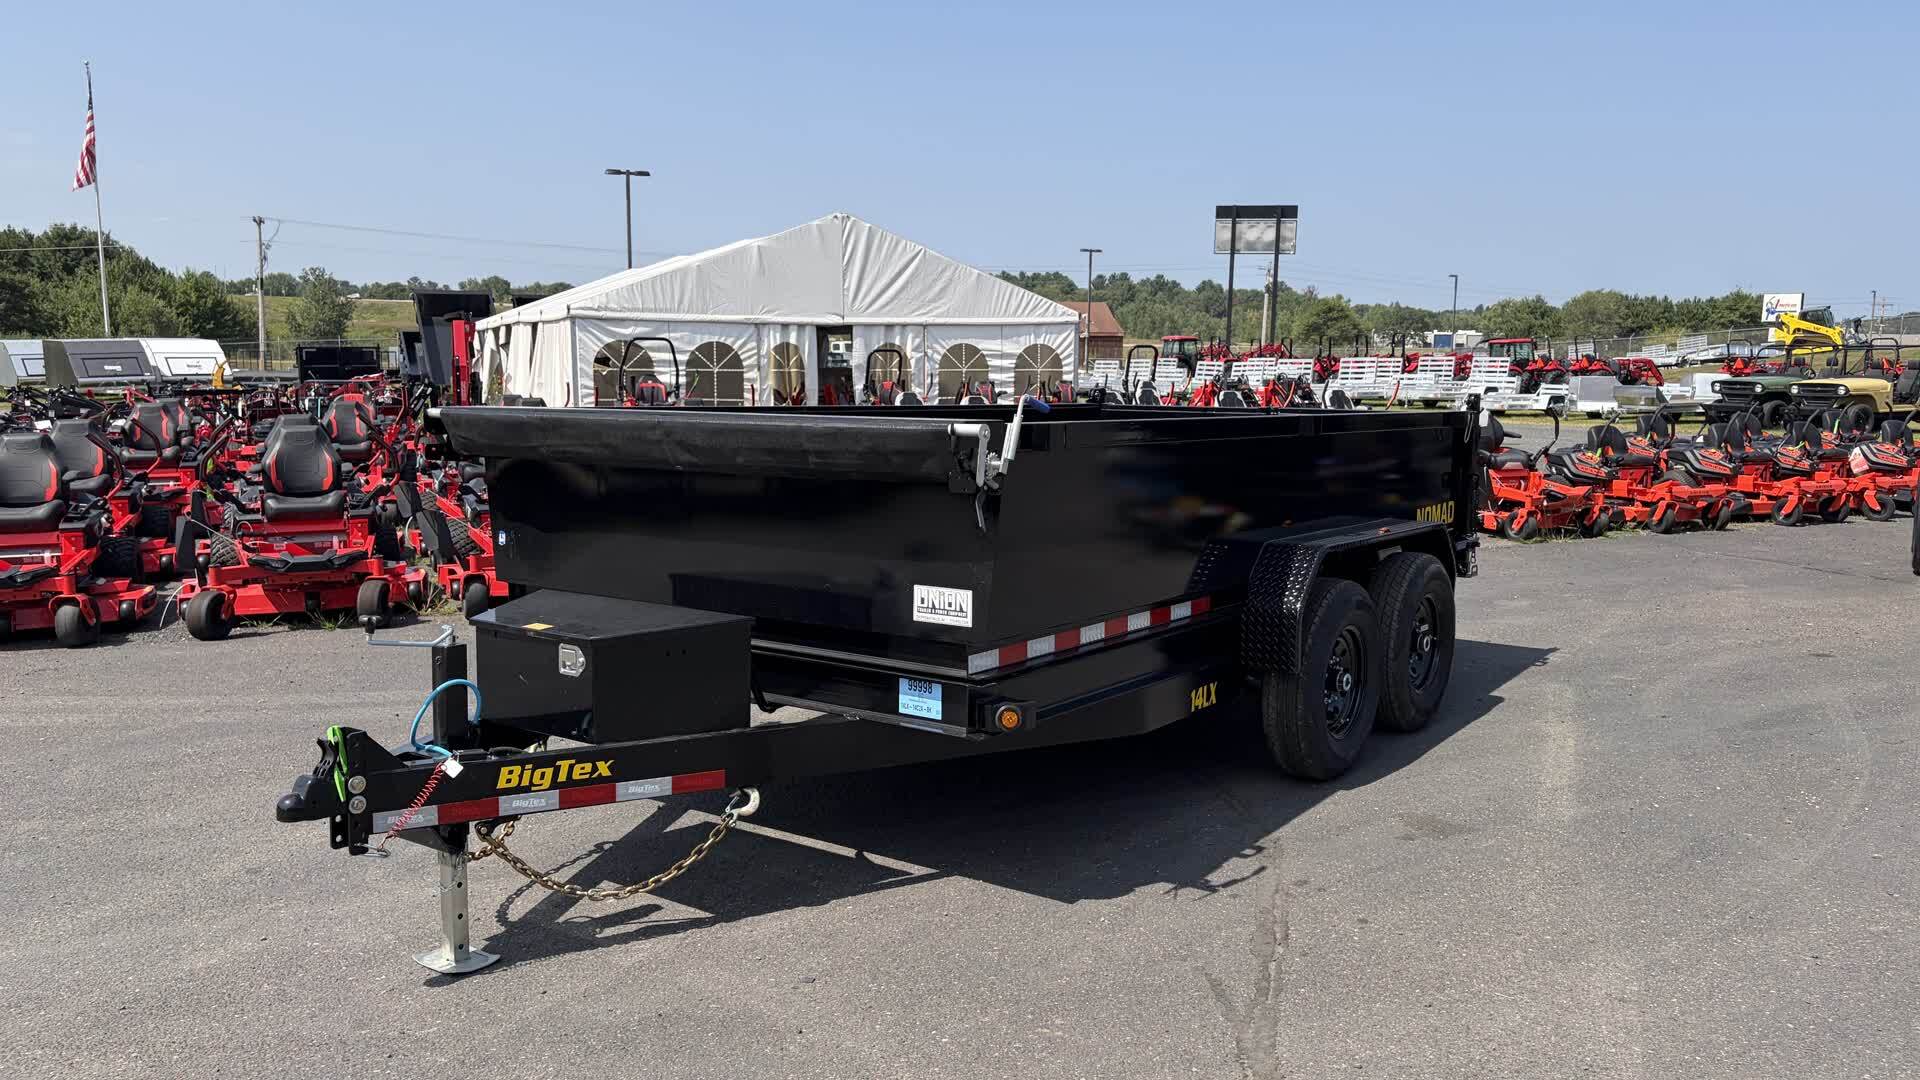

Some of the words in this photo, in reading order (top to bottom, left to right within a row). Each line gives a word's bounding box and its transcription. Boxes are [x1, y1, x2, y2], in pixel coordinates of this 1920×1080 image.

[1416, 501, 1455, 523] NOMAD
[908, 679, 933, 694] 99998
[1190, 681, 1218, 713] 14LX
[496, 759, 614, 791] BigTex
[628, 783, 661, 794] BigTex
[511, 796, 547, 809] BigTex
